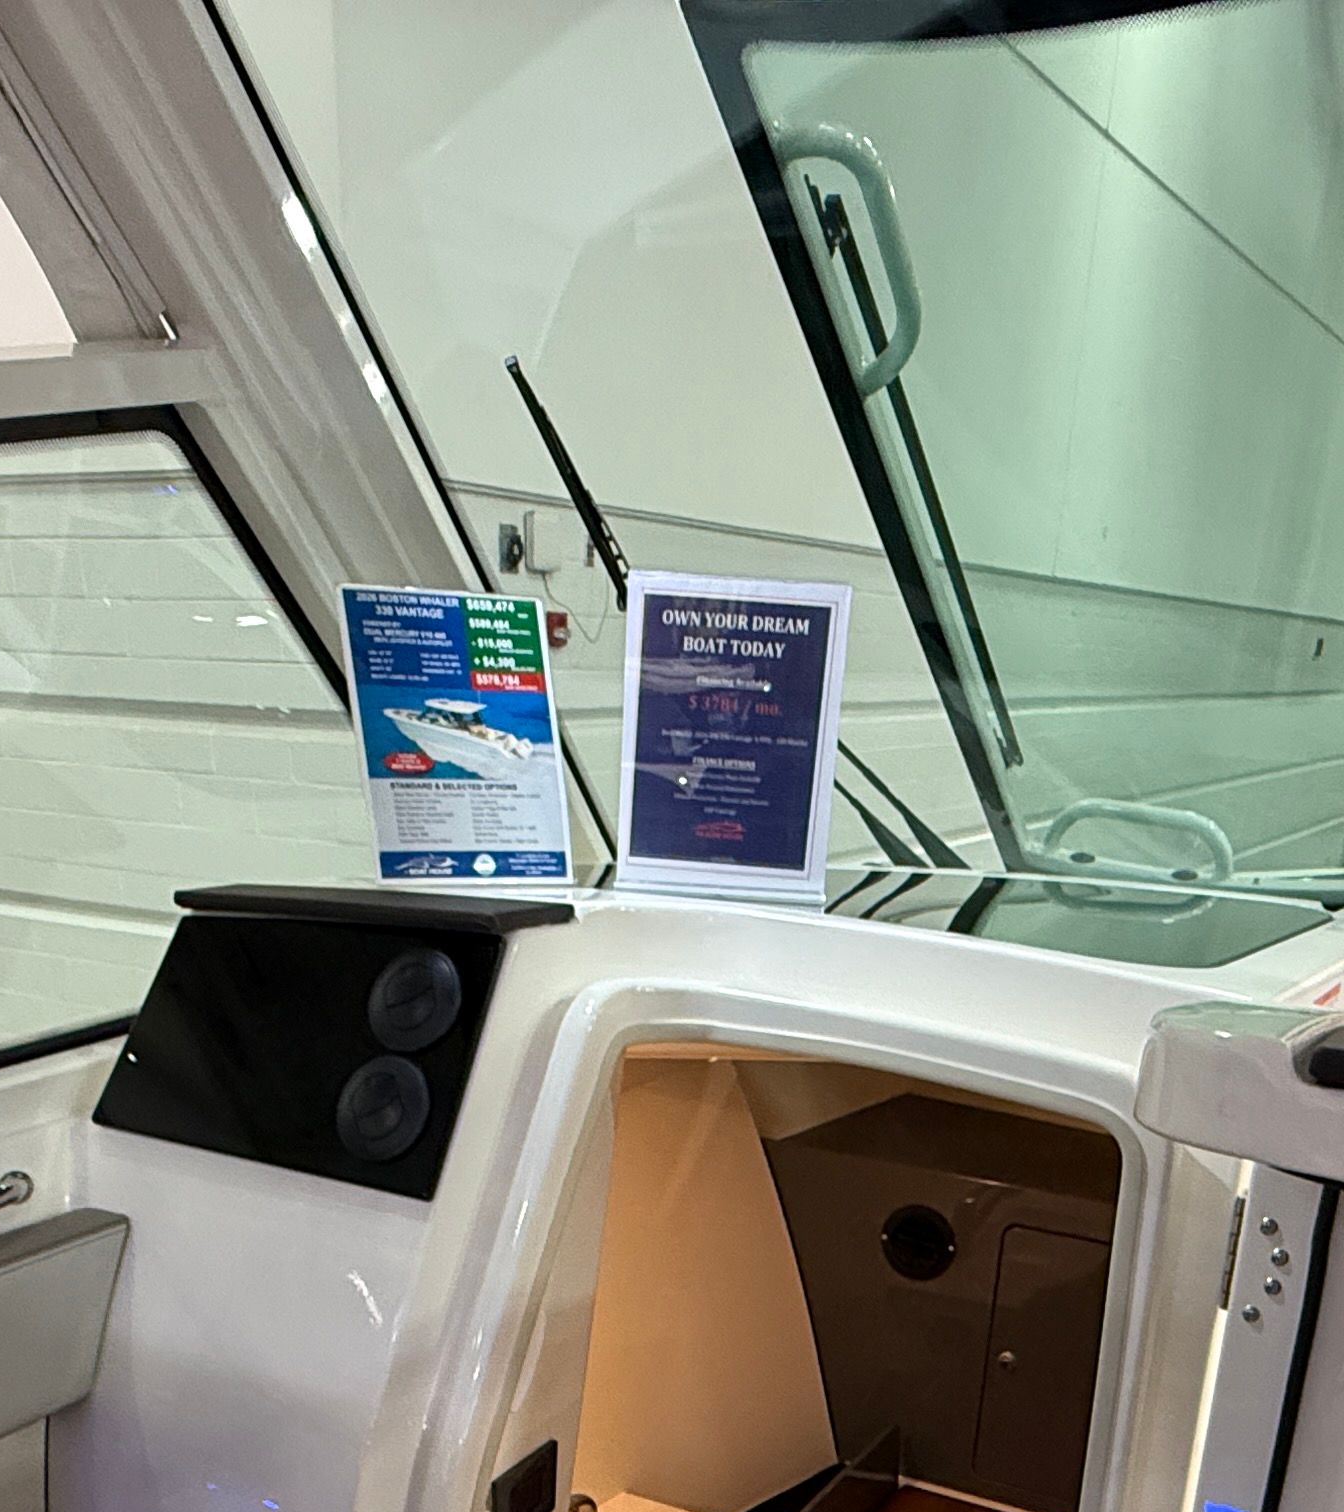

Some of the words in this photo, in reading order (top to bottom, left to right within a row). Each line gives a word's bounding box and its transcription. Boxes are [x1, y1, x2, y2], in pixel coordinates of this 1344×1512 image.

[377, 593, 418, 606] BOSTON
[418, 596, 460, 609] WHALER
[395, 606, 445, 619] VANTAGE
[662, 609, 701, 628] OWN
[705, 611, 748, 631] YOUR
[752, 615, 810, 636] DREAM
[683, 636, 728, 655] BOAT
[730, 638, 786, 660] TODAY
[389, 782, 433, 791] STANDARD
[442, 783, 483, 792] SELECTED
[484, 783, 518, 792] OPTIONS
